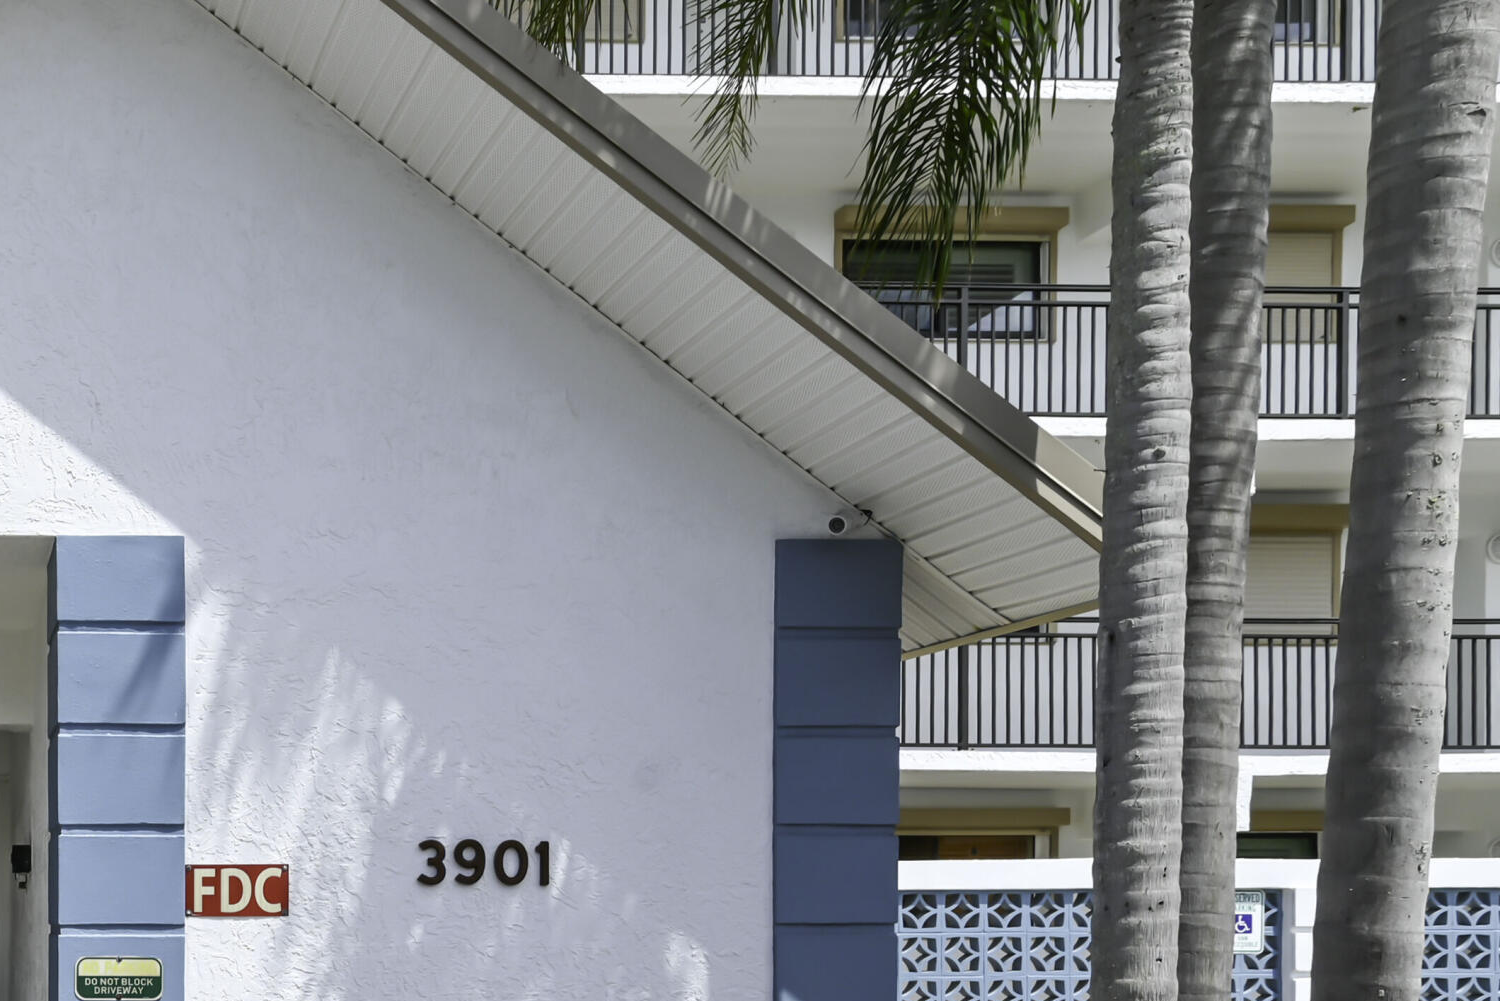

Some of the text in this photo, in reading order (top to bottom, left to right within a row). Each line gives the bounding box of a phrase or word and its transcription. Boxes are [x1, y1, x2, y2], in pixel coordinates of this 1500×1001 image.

[417, 839, 549, 886] 3901
[193, 867, 282, 913] FDC
[84, 978, 154, 986] DO NOT BLOCK
[94, 986, 144, 995] DRIVEWAY
